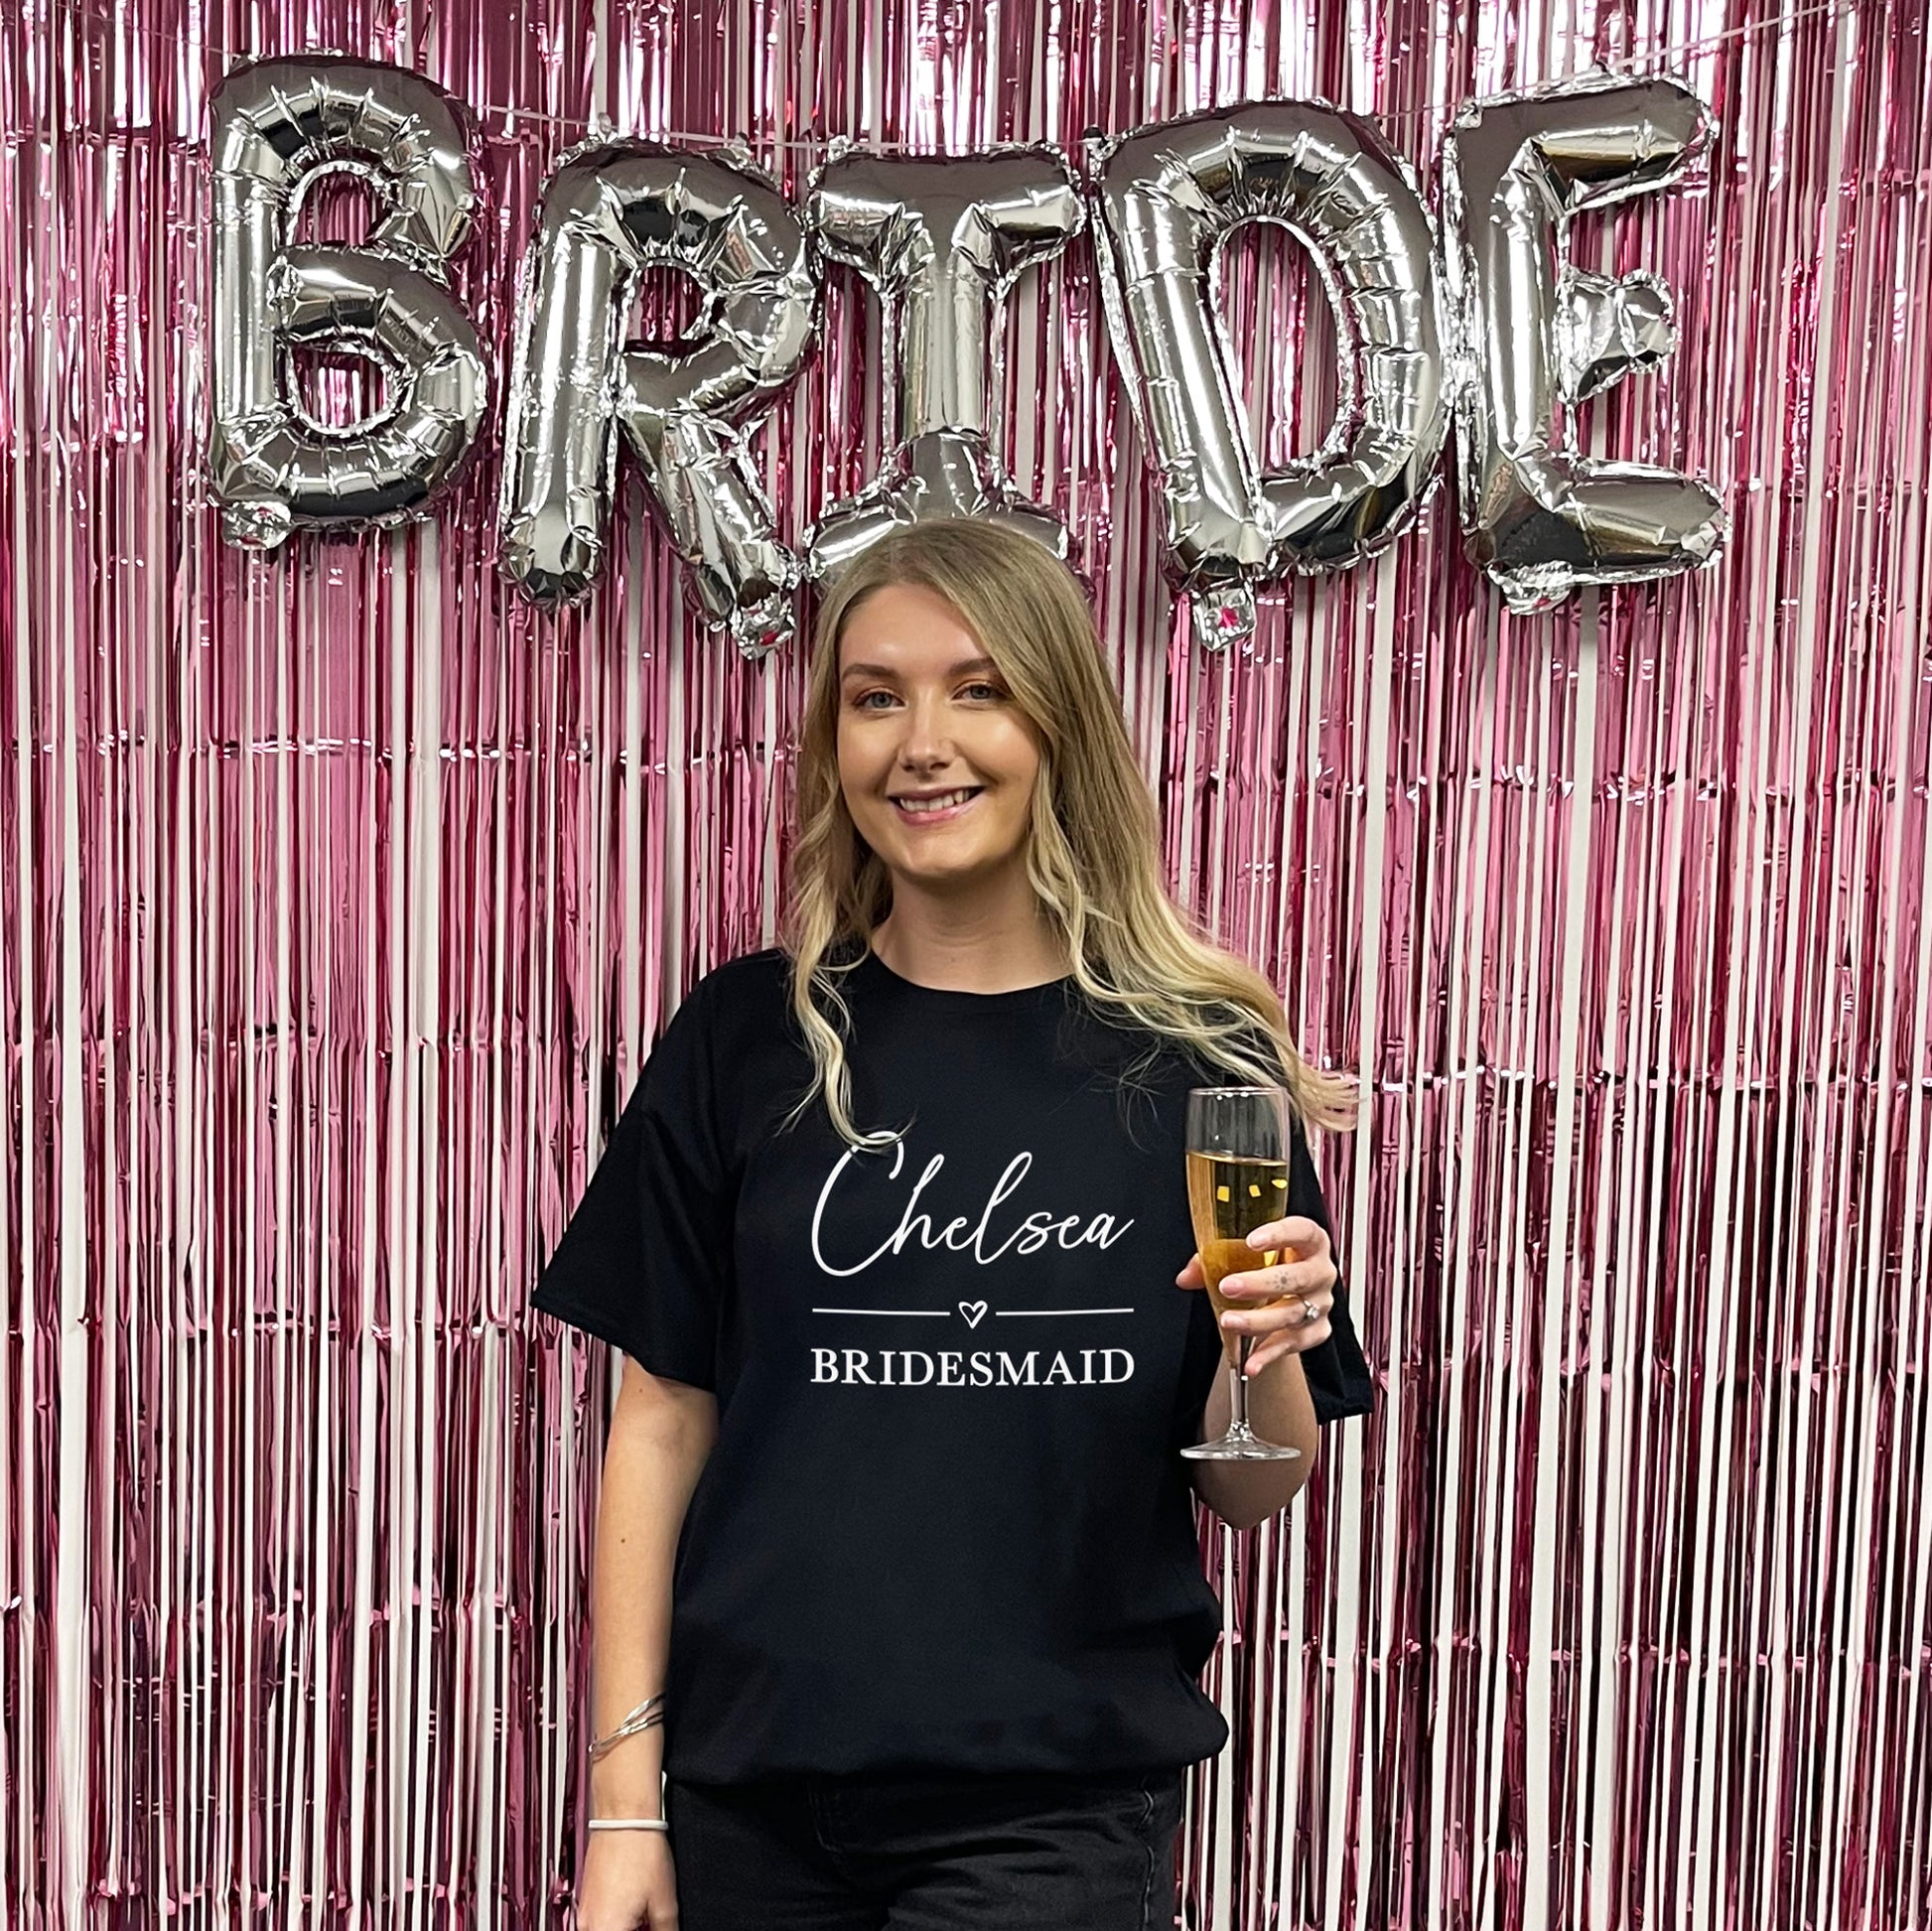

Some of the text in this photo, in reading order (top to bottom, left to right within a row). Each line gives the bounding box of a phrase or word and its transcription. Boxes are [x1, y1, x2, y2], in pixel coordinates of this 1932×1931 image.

[205, 48, 1732, 650] BRIDE
[810, 1130, 1135, 1278] Chelsea
[810, 1348, 1135, 1387] BRIDESMAID
